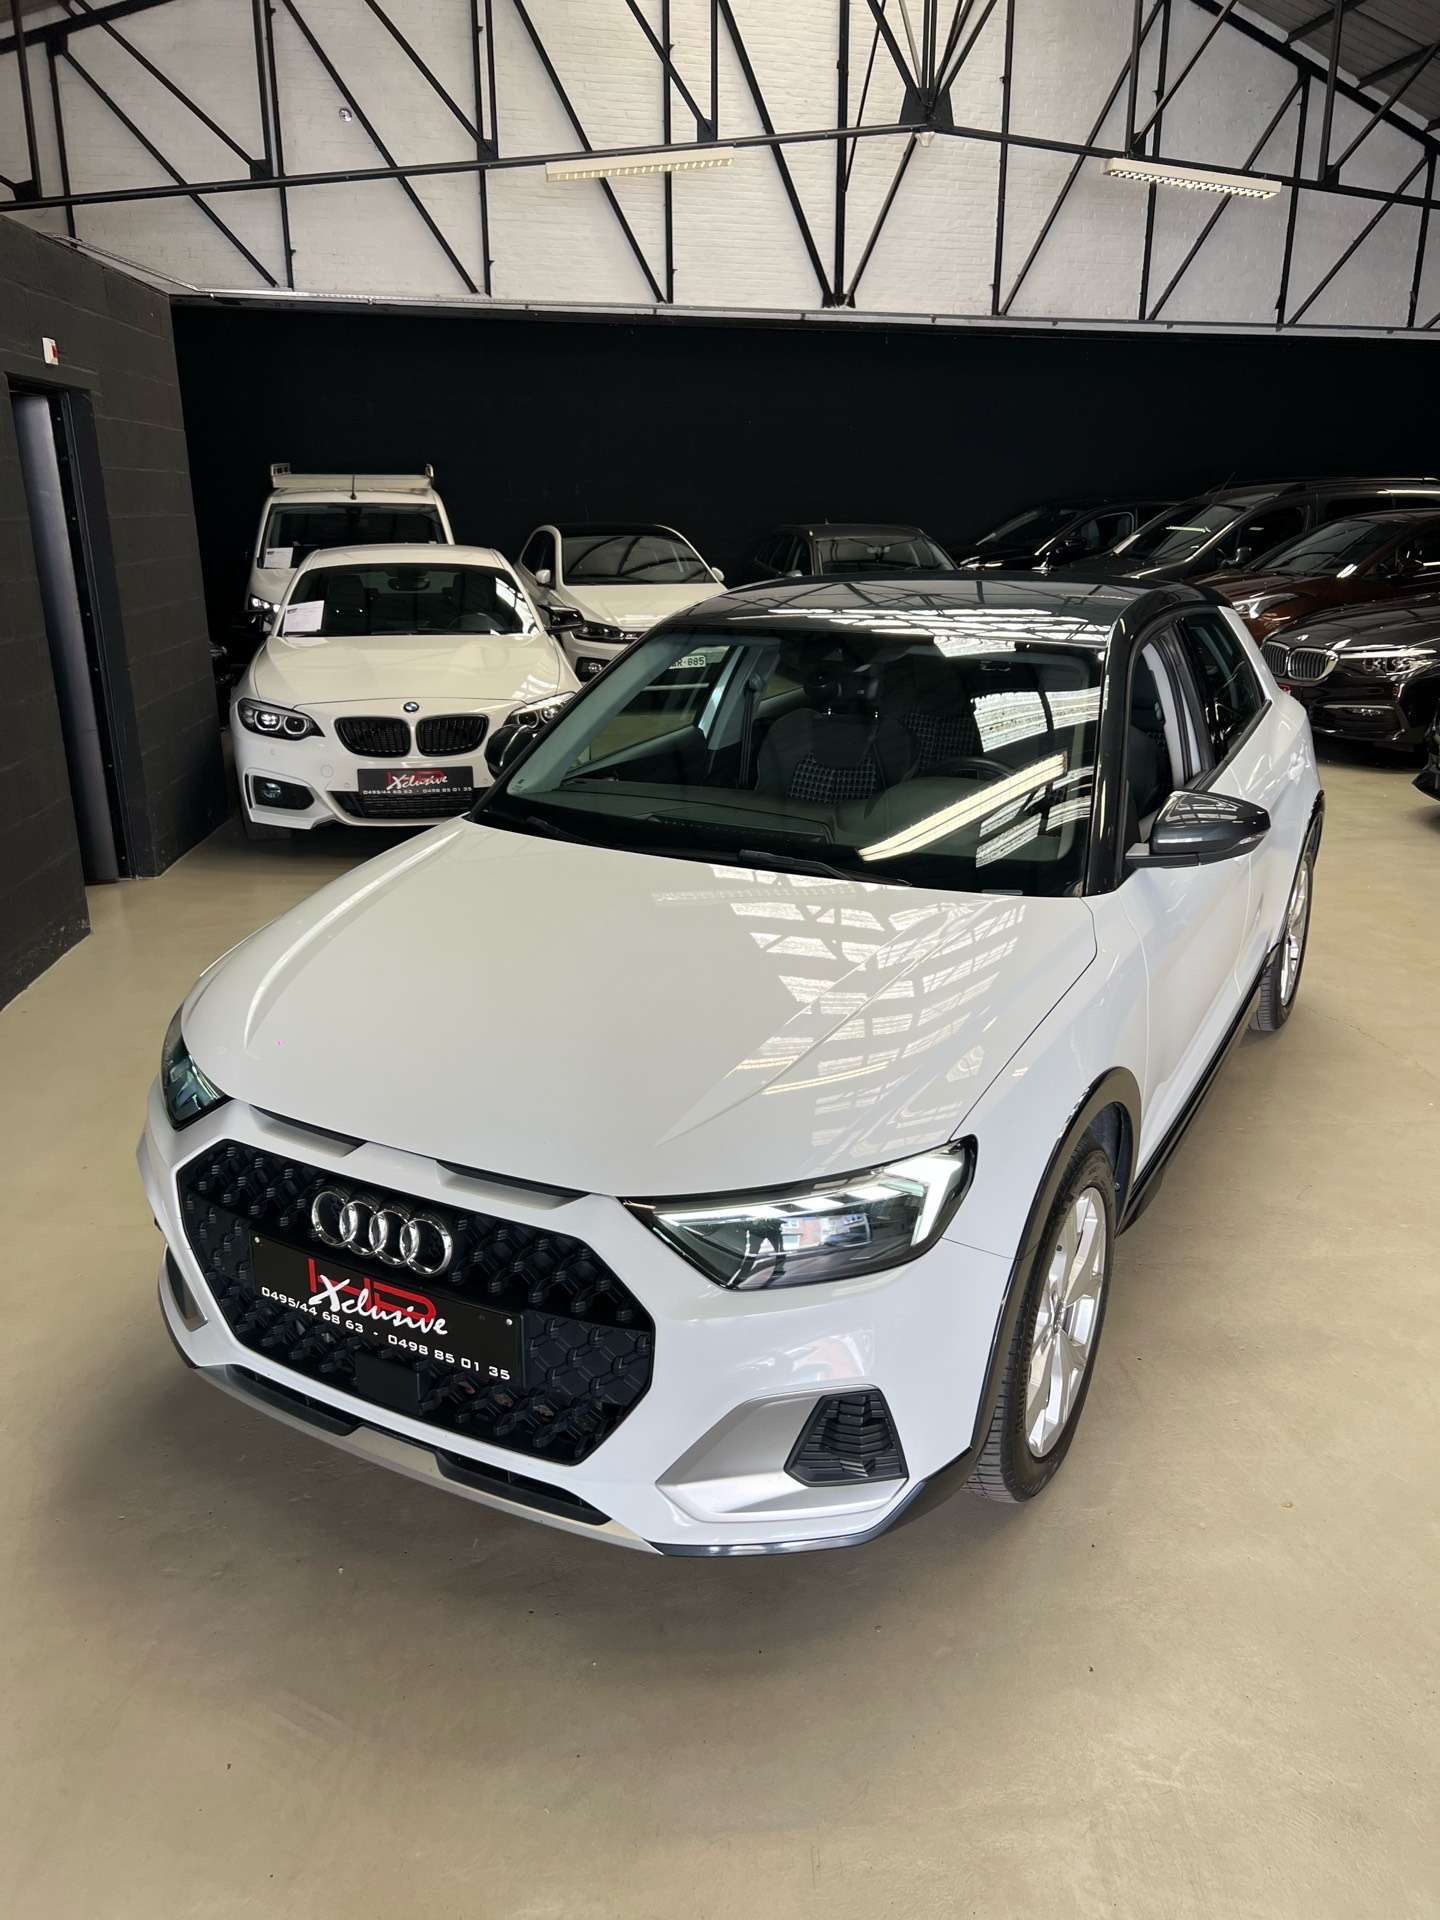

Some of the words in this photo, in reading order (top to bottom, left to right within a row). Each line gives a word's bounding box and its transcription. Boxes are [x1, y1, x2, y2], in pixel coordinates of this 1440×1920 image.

[386, 774, 448, 791] Xclusive
[261, 1286, 317, 1316] 0495/44
[322, 1311, 341, 1325] 68
[345, 1319, 364, 1333] 63
[388, 1334, 429, 1356] 0498
[434, 1349, 455, 1363] 85
[460, 1357, 480, 1372] 01
[488, 1365, 511, 1380] 35
[308, 1274, 449, 1335] Xclusive
